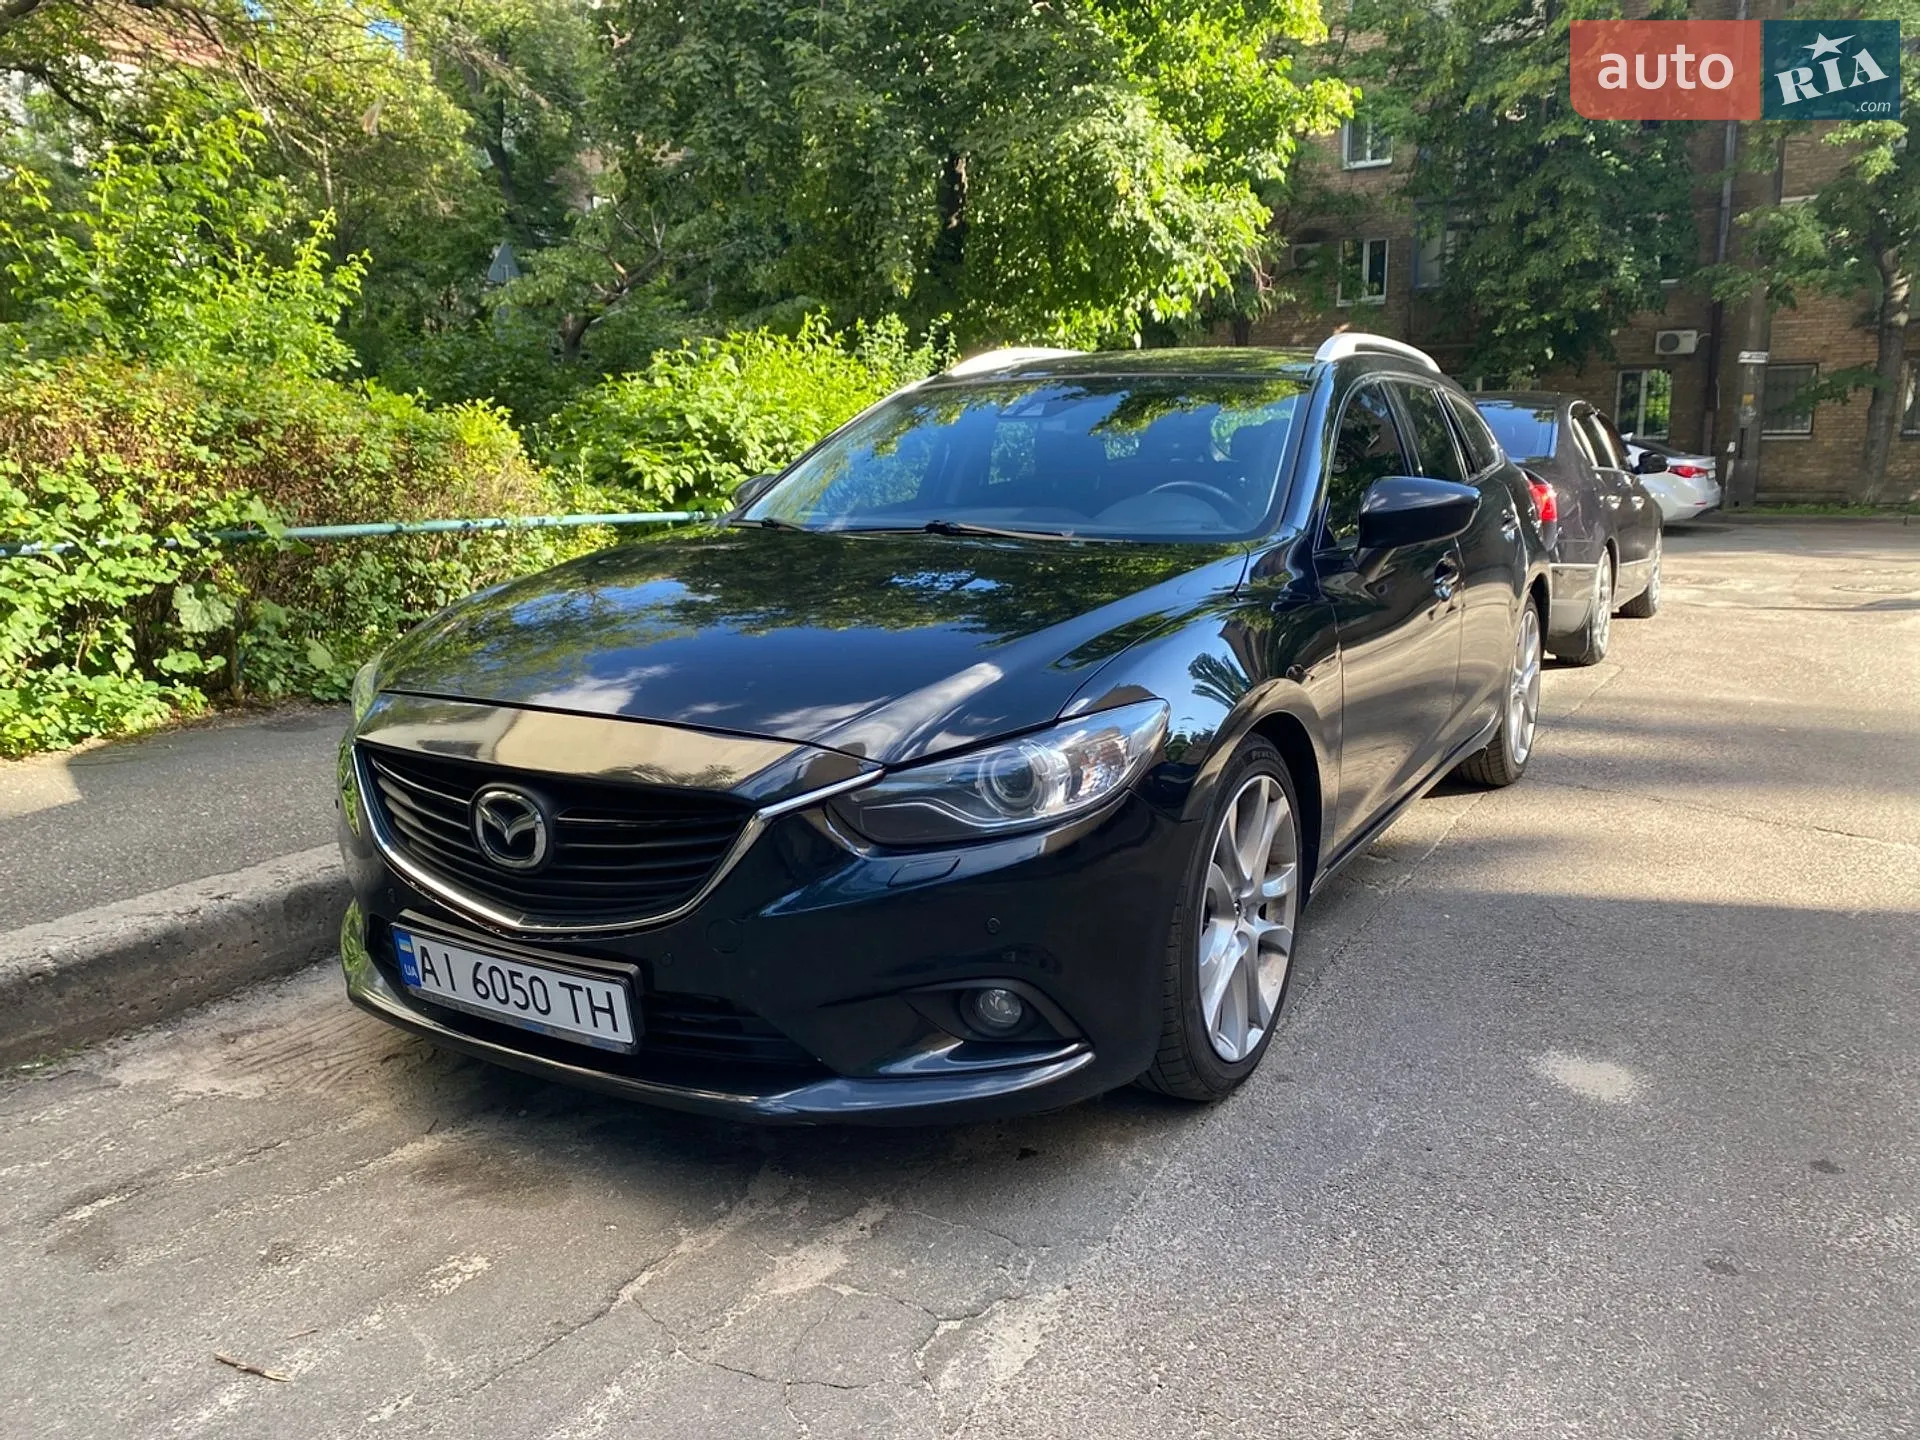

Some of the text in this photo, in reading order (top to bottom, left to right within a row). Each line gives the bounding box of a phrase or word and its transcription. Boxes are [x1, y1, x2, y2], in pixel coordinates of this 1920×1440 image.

[404, 964, 418, 979] UA
[419, 945, 619, 1033] AI 6050 TH
